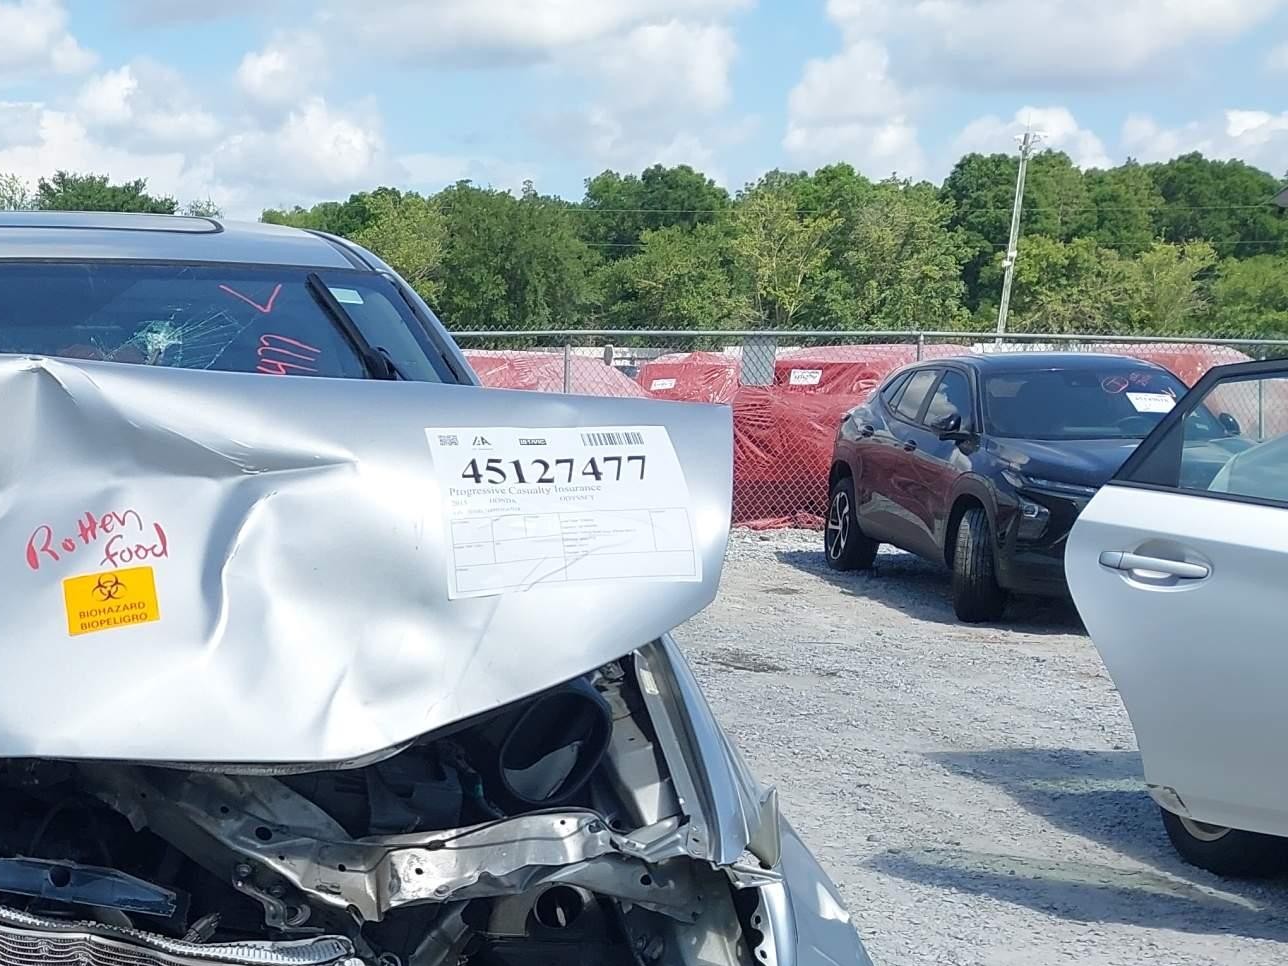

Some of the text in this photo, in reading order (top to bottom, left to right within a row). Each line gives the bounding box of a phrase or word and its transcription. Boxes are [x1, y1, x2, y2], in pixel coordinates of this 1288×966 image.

[461, 454, 647, 485] 45127477
[449, 484, 601, 498] Progressive Casualty Insurance
[26, 509, 143, 570] Rotten
[79, 601, 146, 619] BIOHAZARD
[80, 612, 149, 631] BIOPELIGRO
